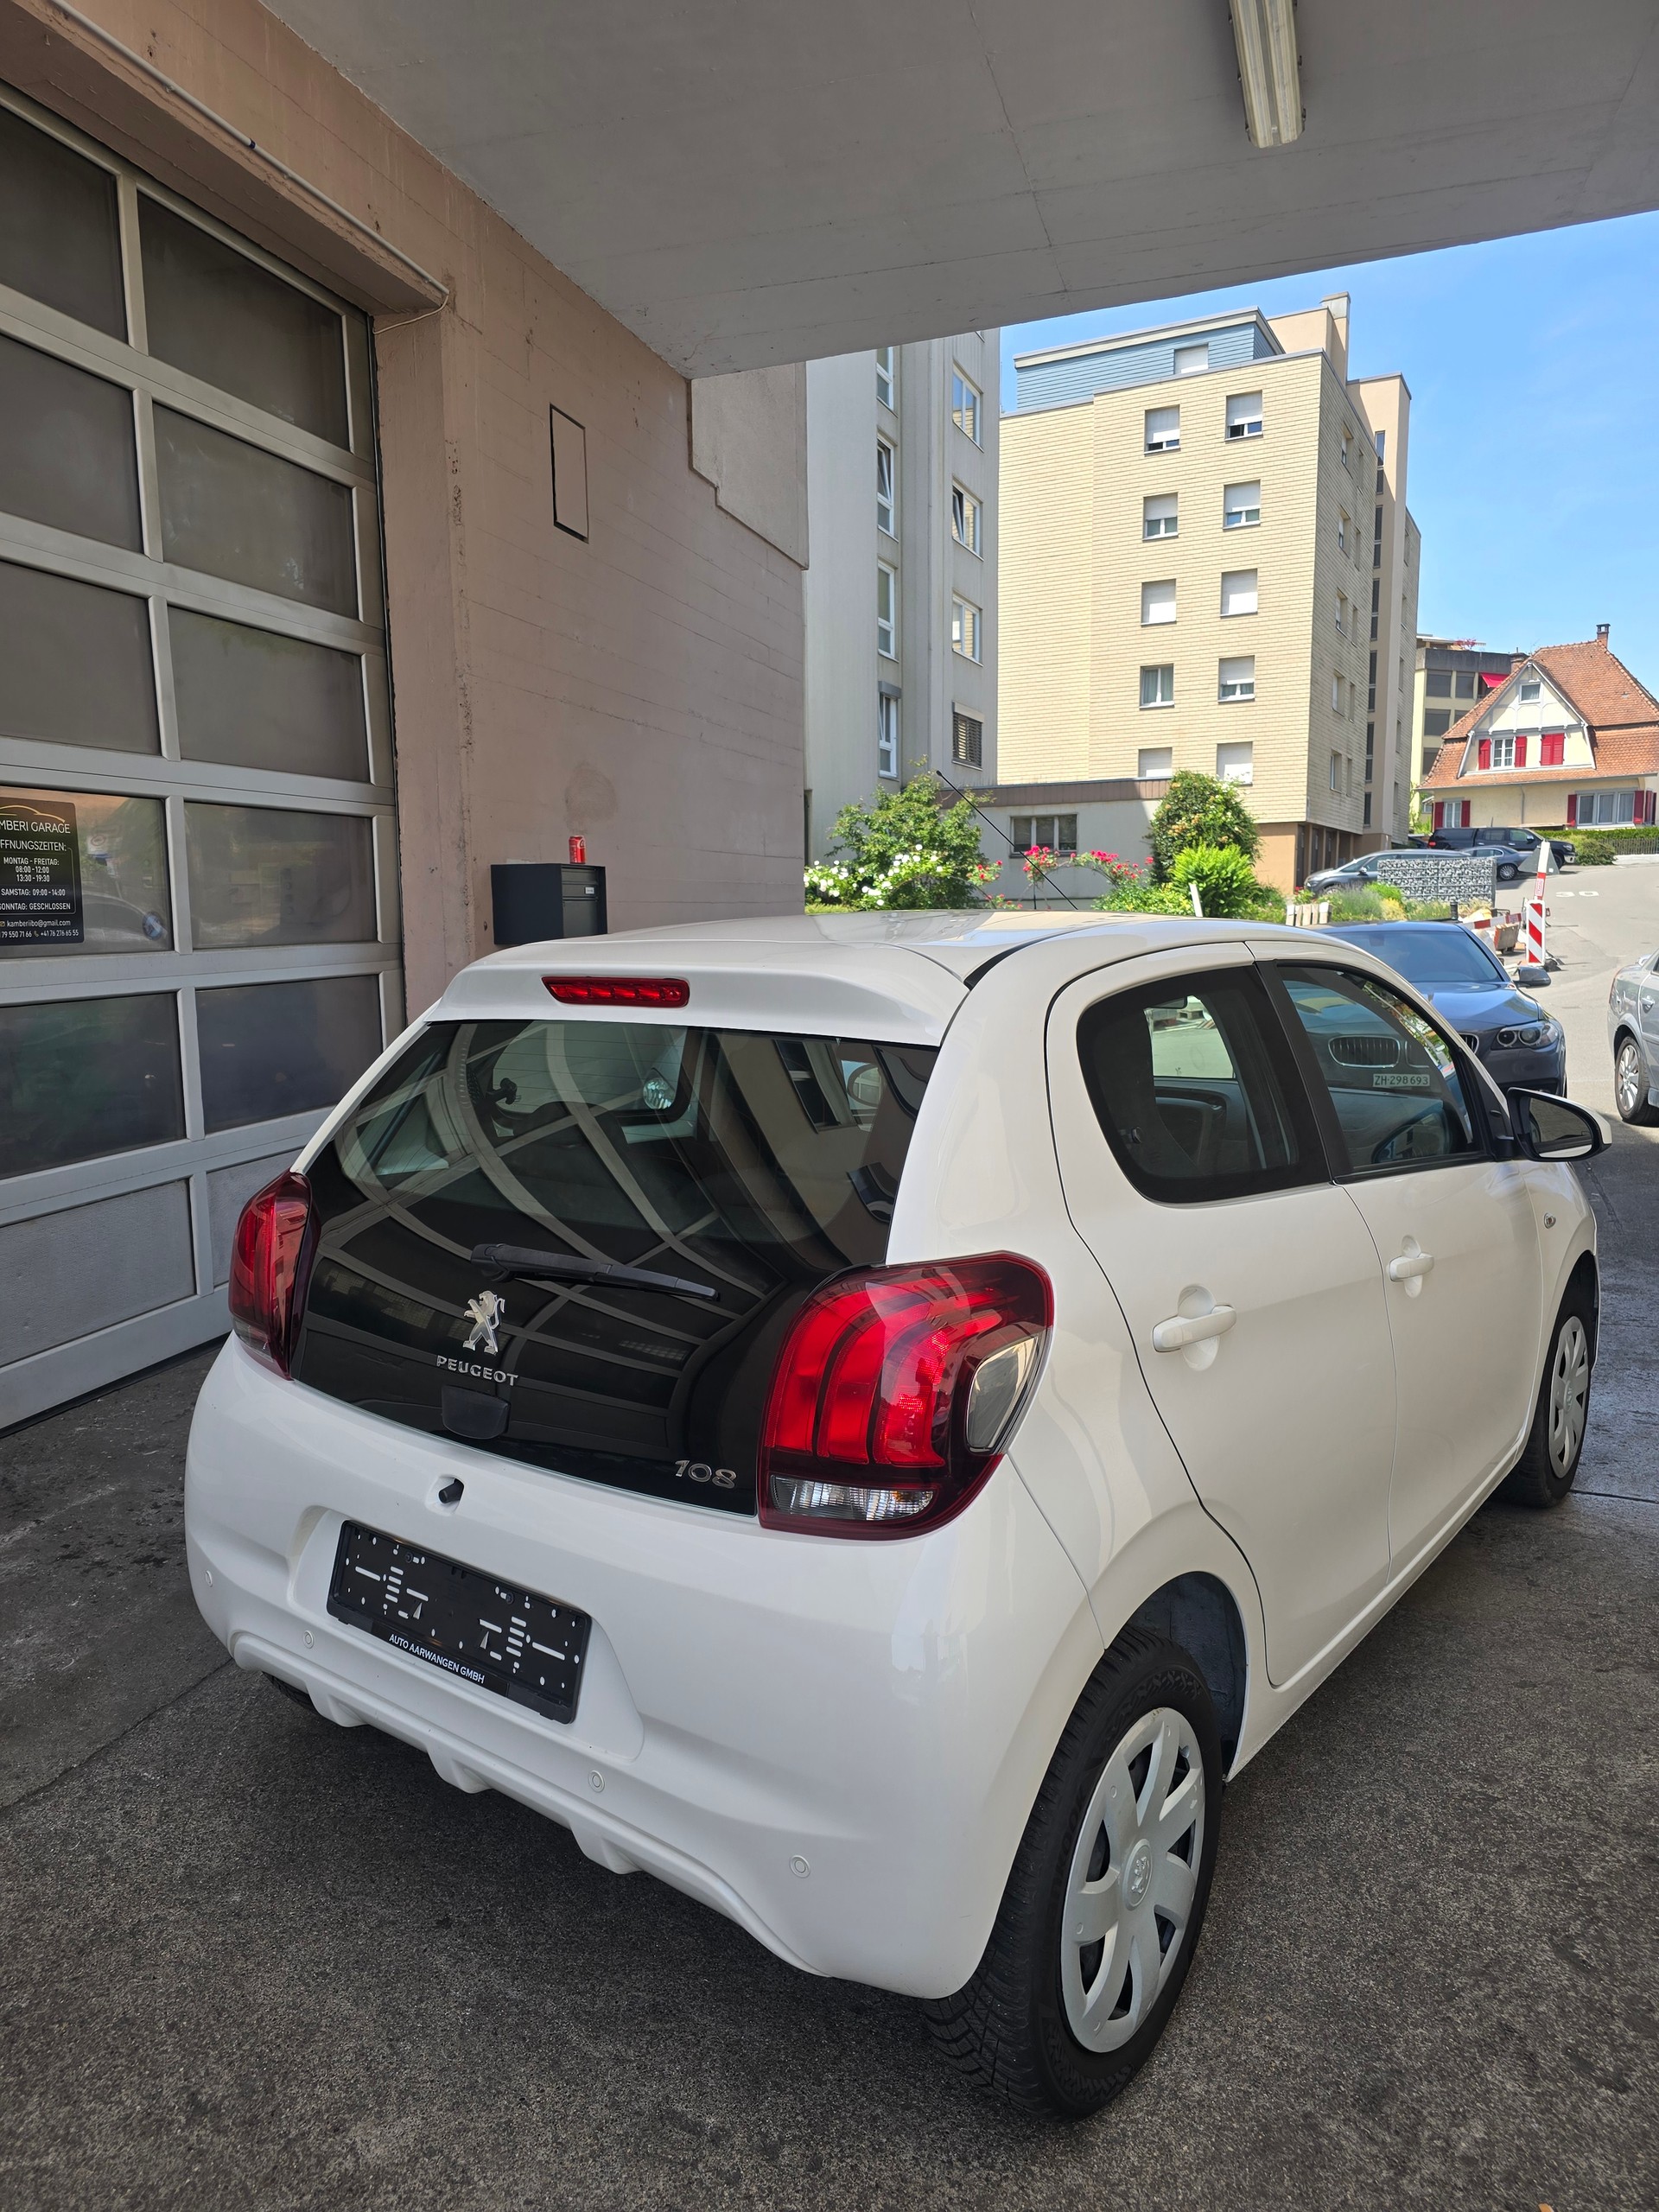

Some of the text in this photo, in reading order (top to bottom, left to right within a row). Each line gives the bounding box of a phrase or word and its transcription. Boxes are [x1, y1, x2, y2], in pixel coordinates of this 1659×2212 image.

[31, 822, 71, 834] GARAGE
[436, 1355, 518, 1387] PEUGEOT
[675, 1459, 738, 1490] 108
[389, 1633, 486, 1684] AUTO AARWANGEN GMBH
